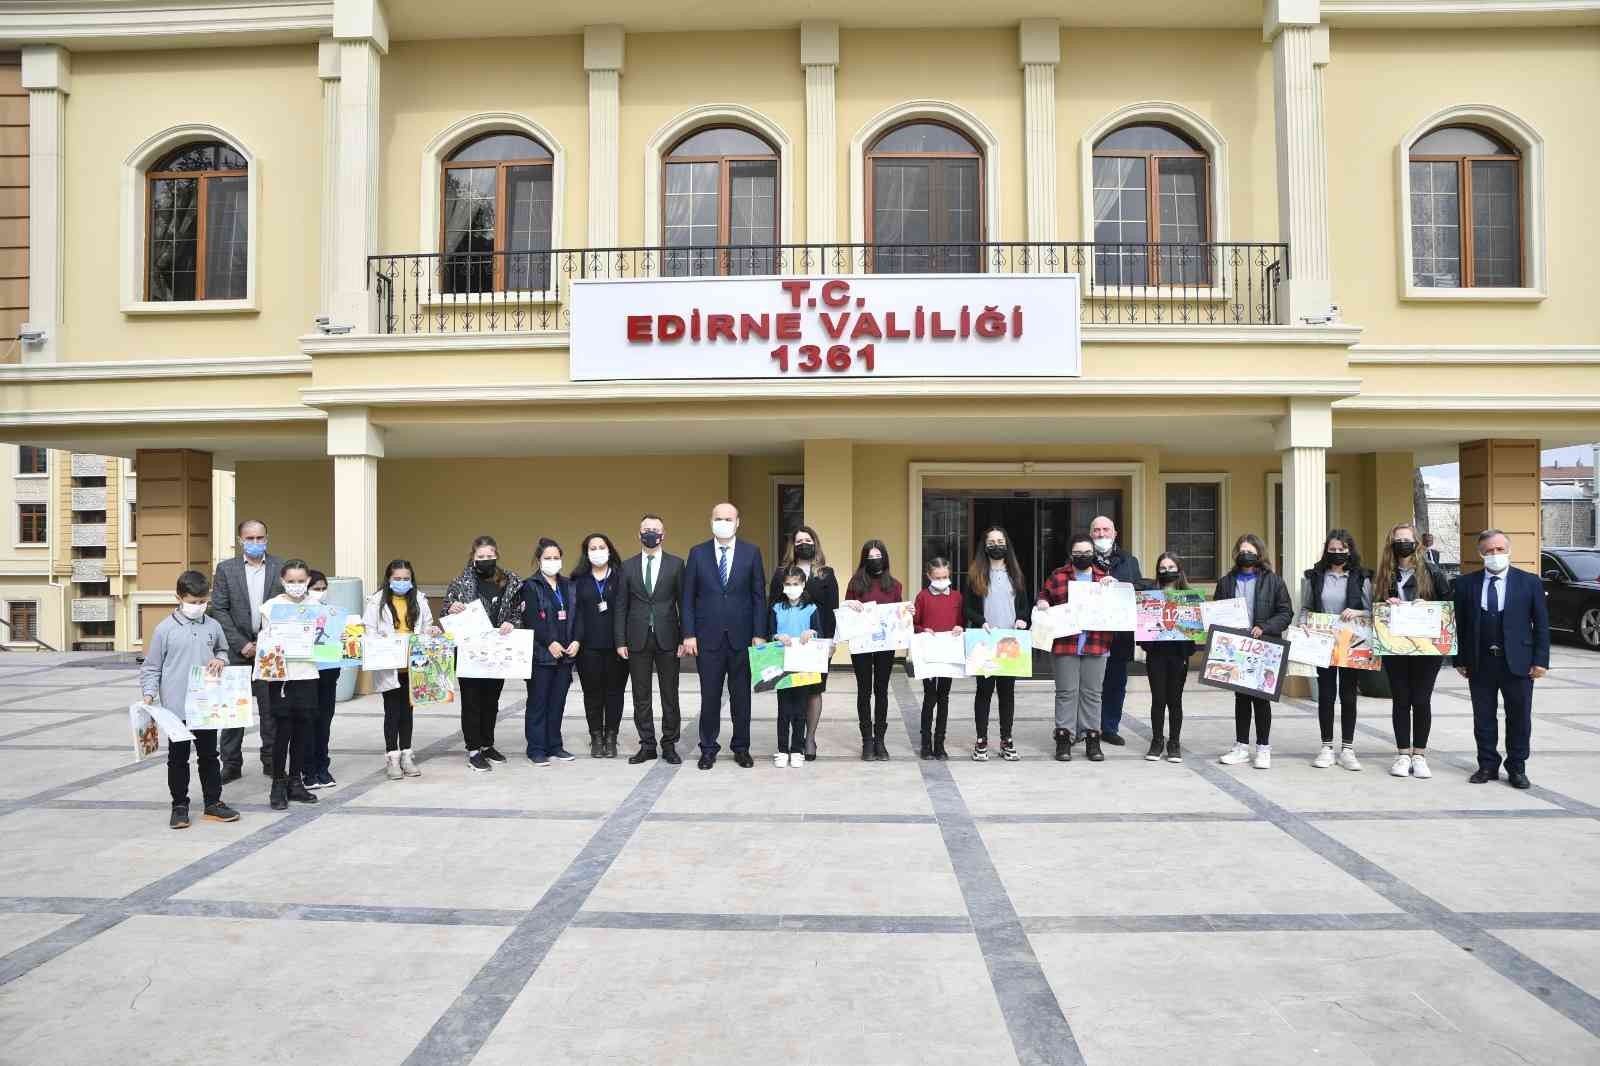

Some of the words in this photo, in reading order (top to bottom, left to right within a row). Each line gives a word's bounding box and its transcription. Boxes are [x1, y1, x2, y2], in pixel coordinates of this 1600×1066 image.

[782, 279, 865, 307] T.C.
[628, 308, 802, 343] EDİRNE
[819, 305, 1022, 341] VALİLİĞİ
[771, 344, 875, 371] 1361
[1239, 638, 1265, 655] 112
